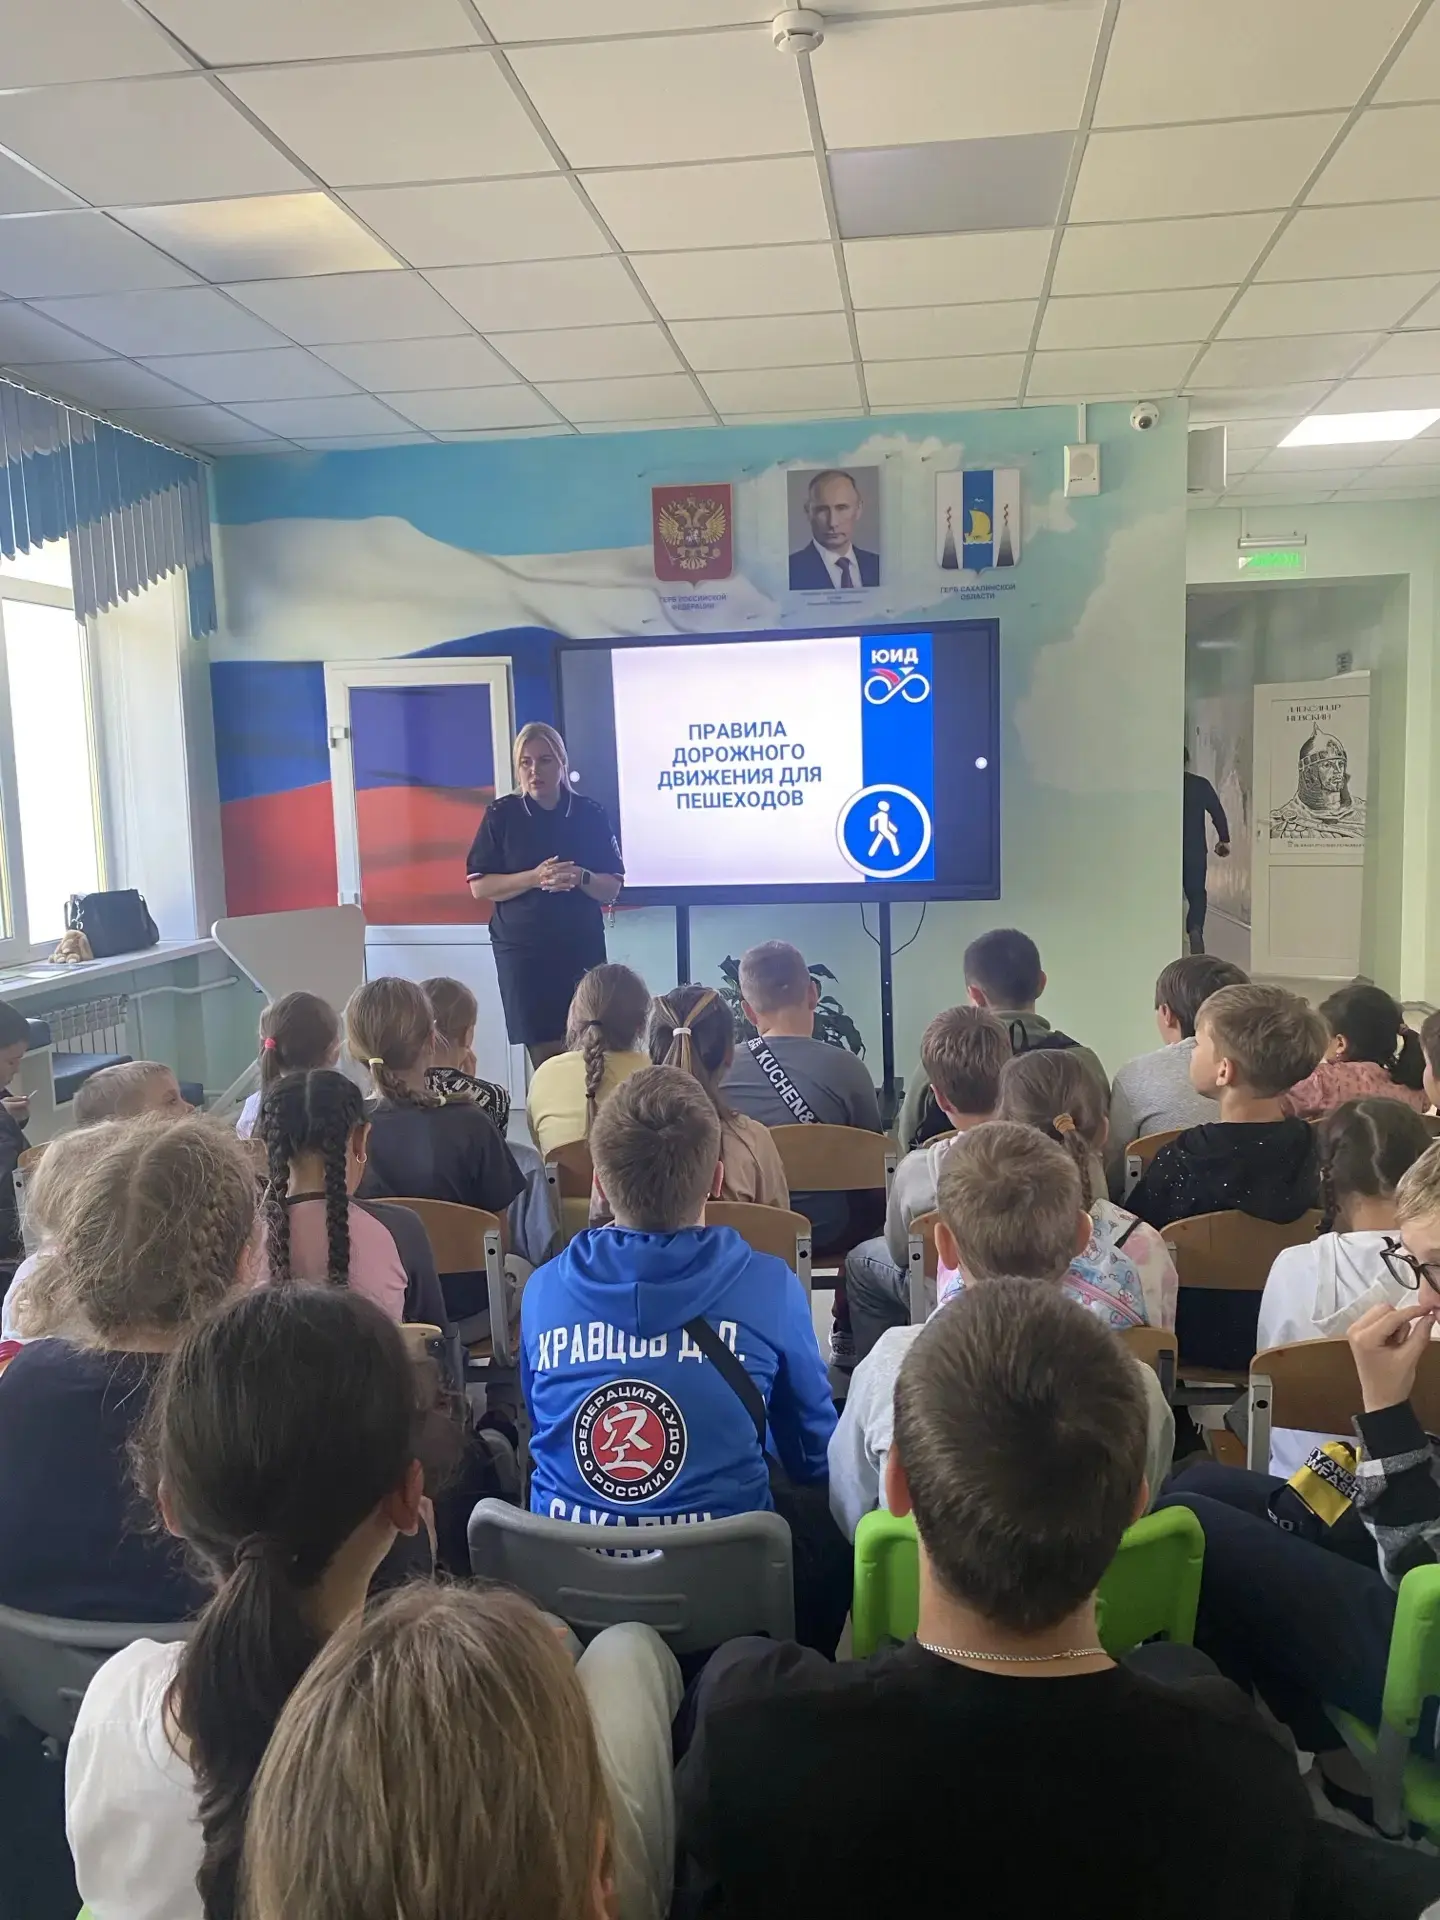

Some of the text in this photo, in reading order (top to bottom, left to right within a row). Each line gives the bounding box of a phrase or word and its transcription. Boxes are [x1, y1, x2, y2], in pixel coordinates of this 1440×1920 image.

[871, 647, 919, 665] ЮИД
[688, 720, 787, 741] ПРАВИЛА
[672, 743, 805, 767] ДОРОЖНОГО
[657, 765, 822, 790] ДВИЖЕНИЯ ДЛЯ
[676, 789, 804, 810] ПЕШЕХОДОВ
[579, 1386, 680, 1456] ФЕДЕРАЦИЯ КУДО
[592, 1472, 666, 1497] РОССИИ
